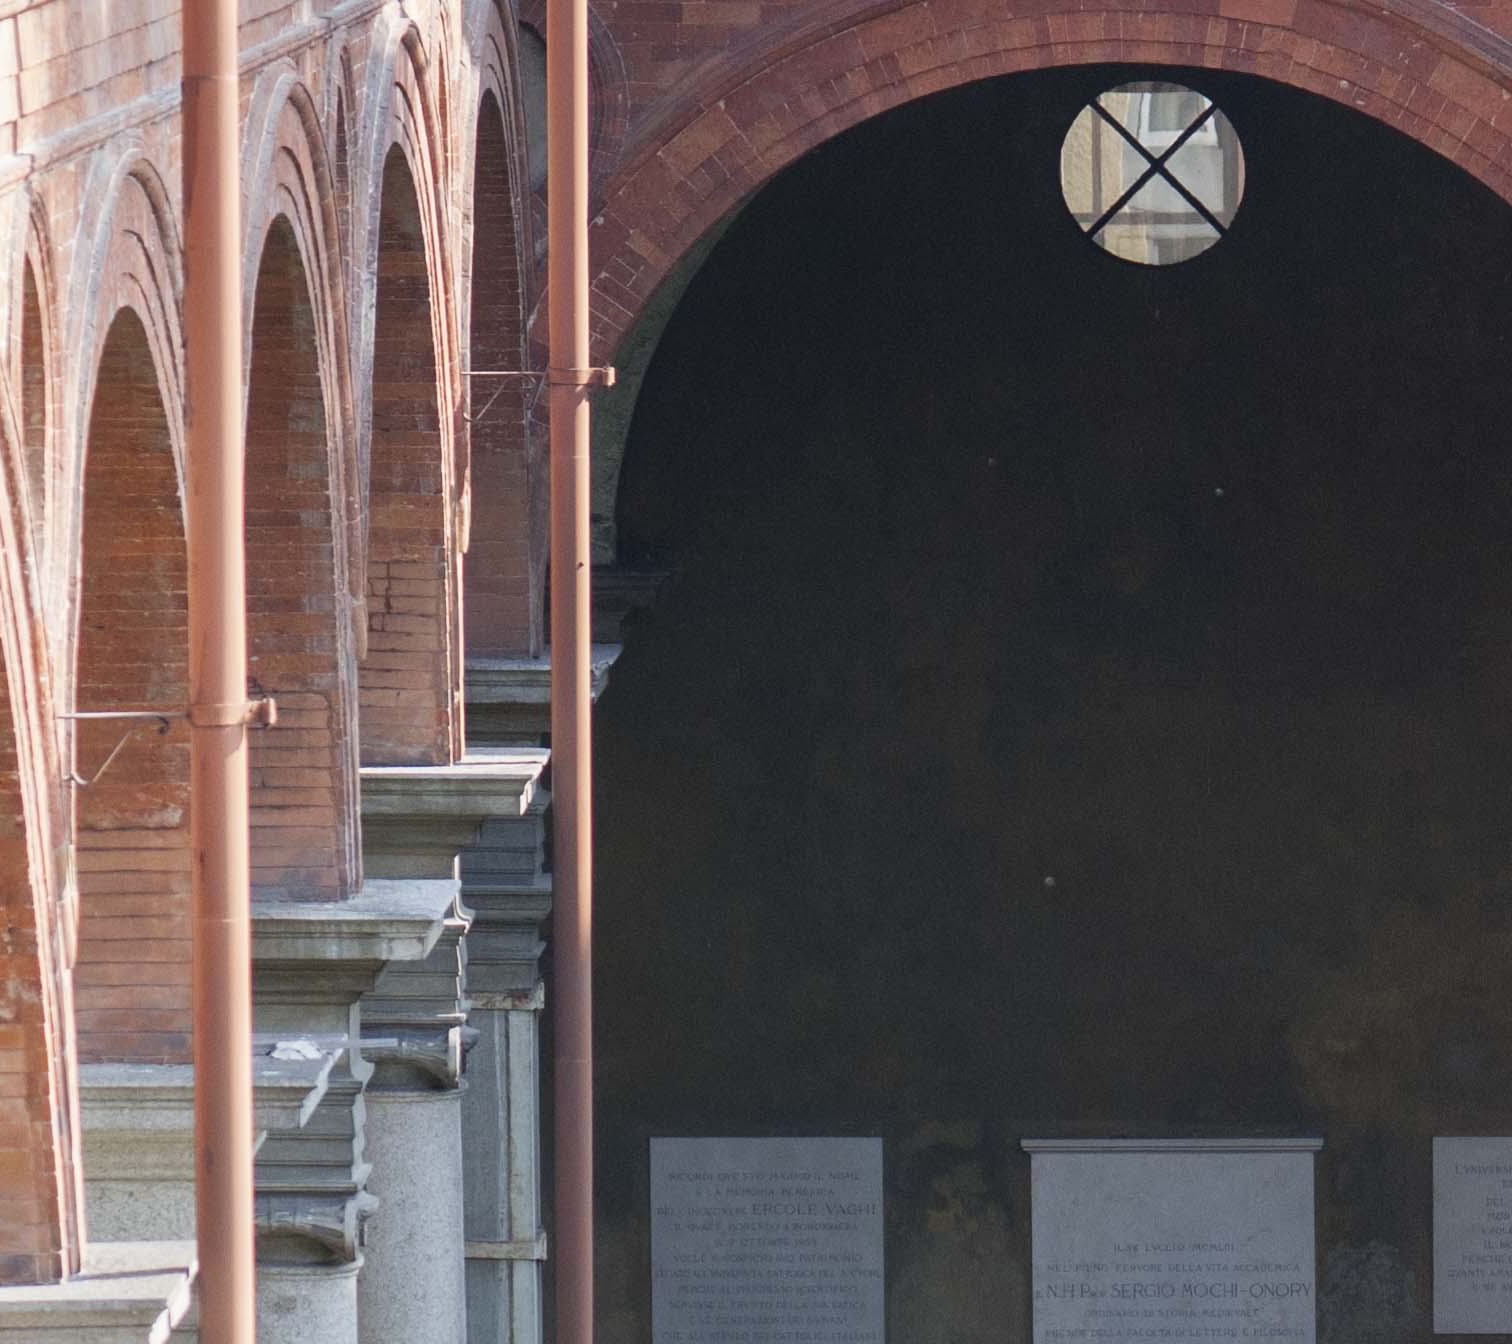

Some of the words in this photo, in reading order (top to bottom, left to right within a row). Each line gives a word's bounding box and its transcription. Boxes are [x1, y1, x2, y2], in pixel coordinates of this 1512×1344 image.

[751, 1203, 817, 1216] ERCOLE
[825, 1203, 876, 1216] VAGHI
[1111, 1282, 1175, 1299] SERGIO
[1181, 1282, 1312, 1299] MOCHI-ONORY
